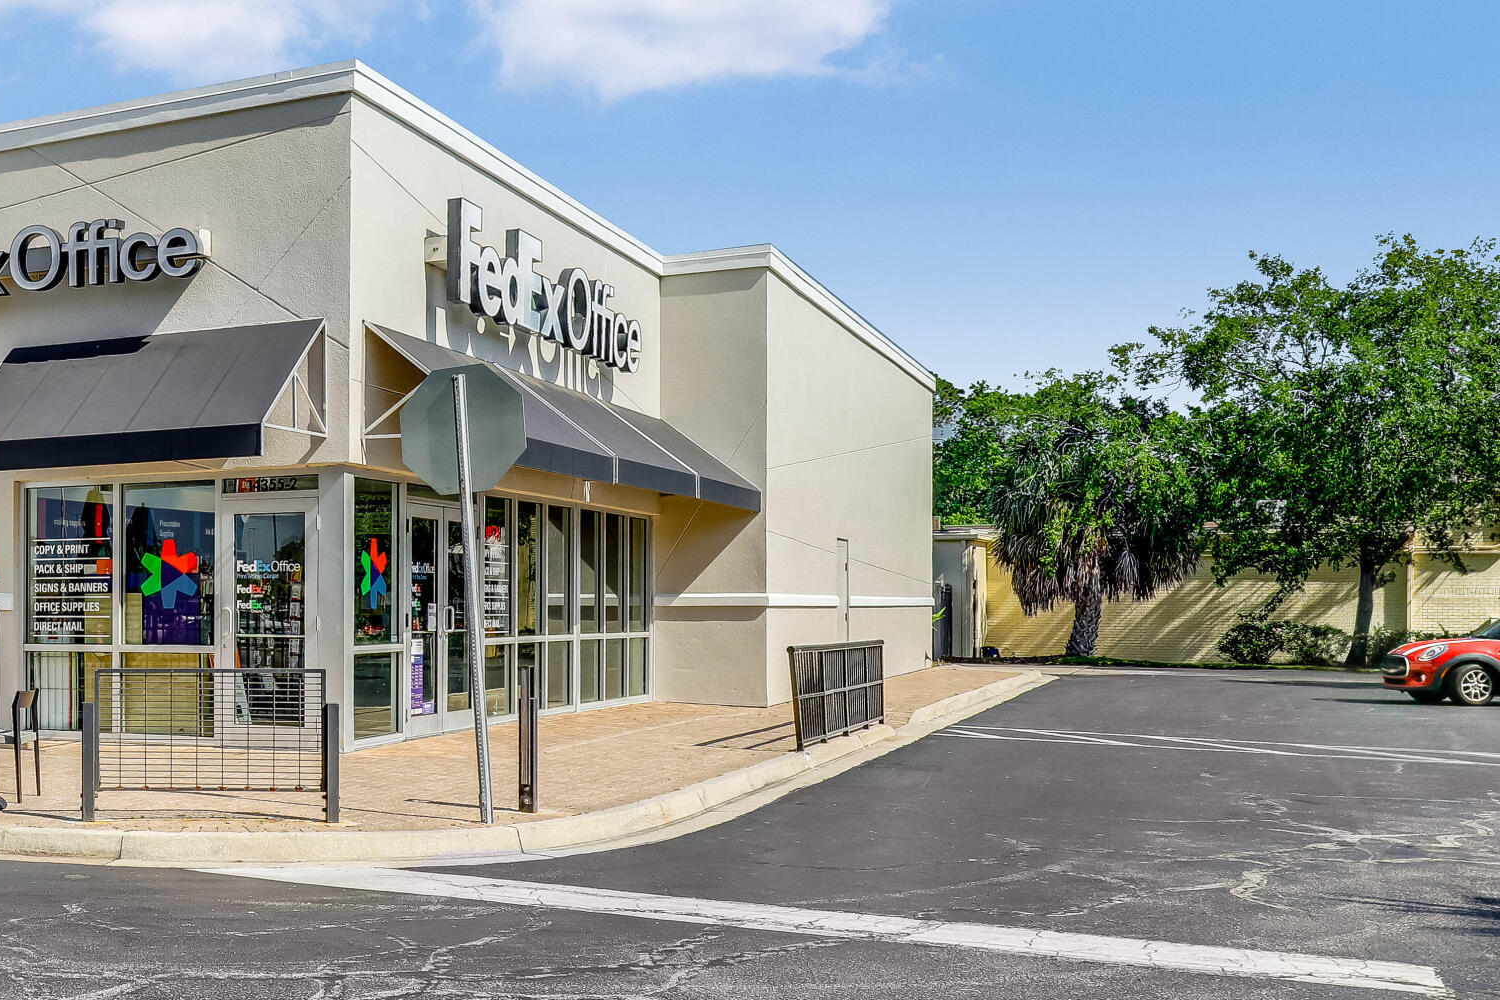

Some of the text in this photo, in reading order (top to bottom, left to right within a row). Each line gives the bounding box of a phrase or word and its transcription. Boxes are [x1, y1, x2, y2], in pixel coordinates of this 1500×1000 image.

[9, 219, 204, 292] Office
[446, 197, 642, 373] FedEx Office
[34, 544, 90, 555] COPY & PRINT
[34, 563, 84, 574] PACK & SHIP
[236, 560, 300, 572] FedEx Office
[34, 582, 109, 593] SIGNS & BANNERS
[236, 584, 262, 594] FedEx
[33, 602, 100, 612] OFFICE SUPPLIES
[236, 600, 262, 609] FedEx
[33, 621, 84, 631] DIRECT MAIL
